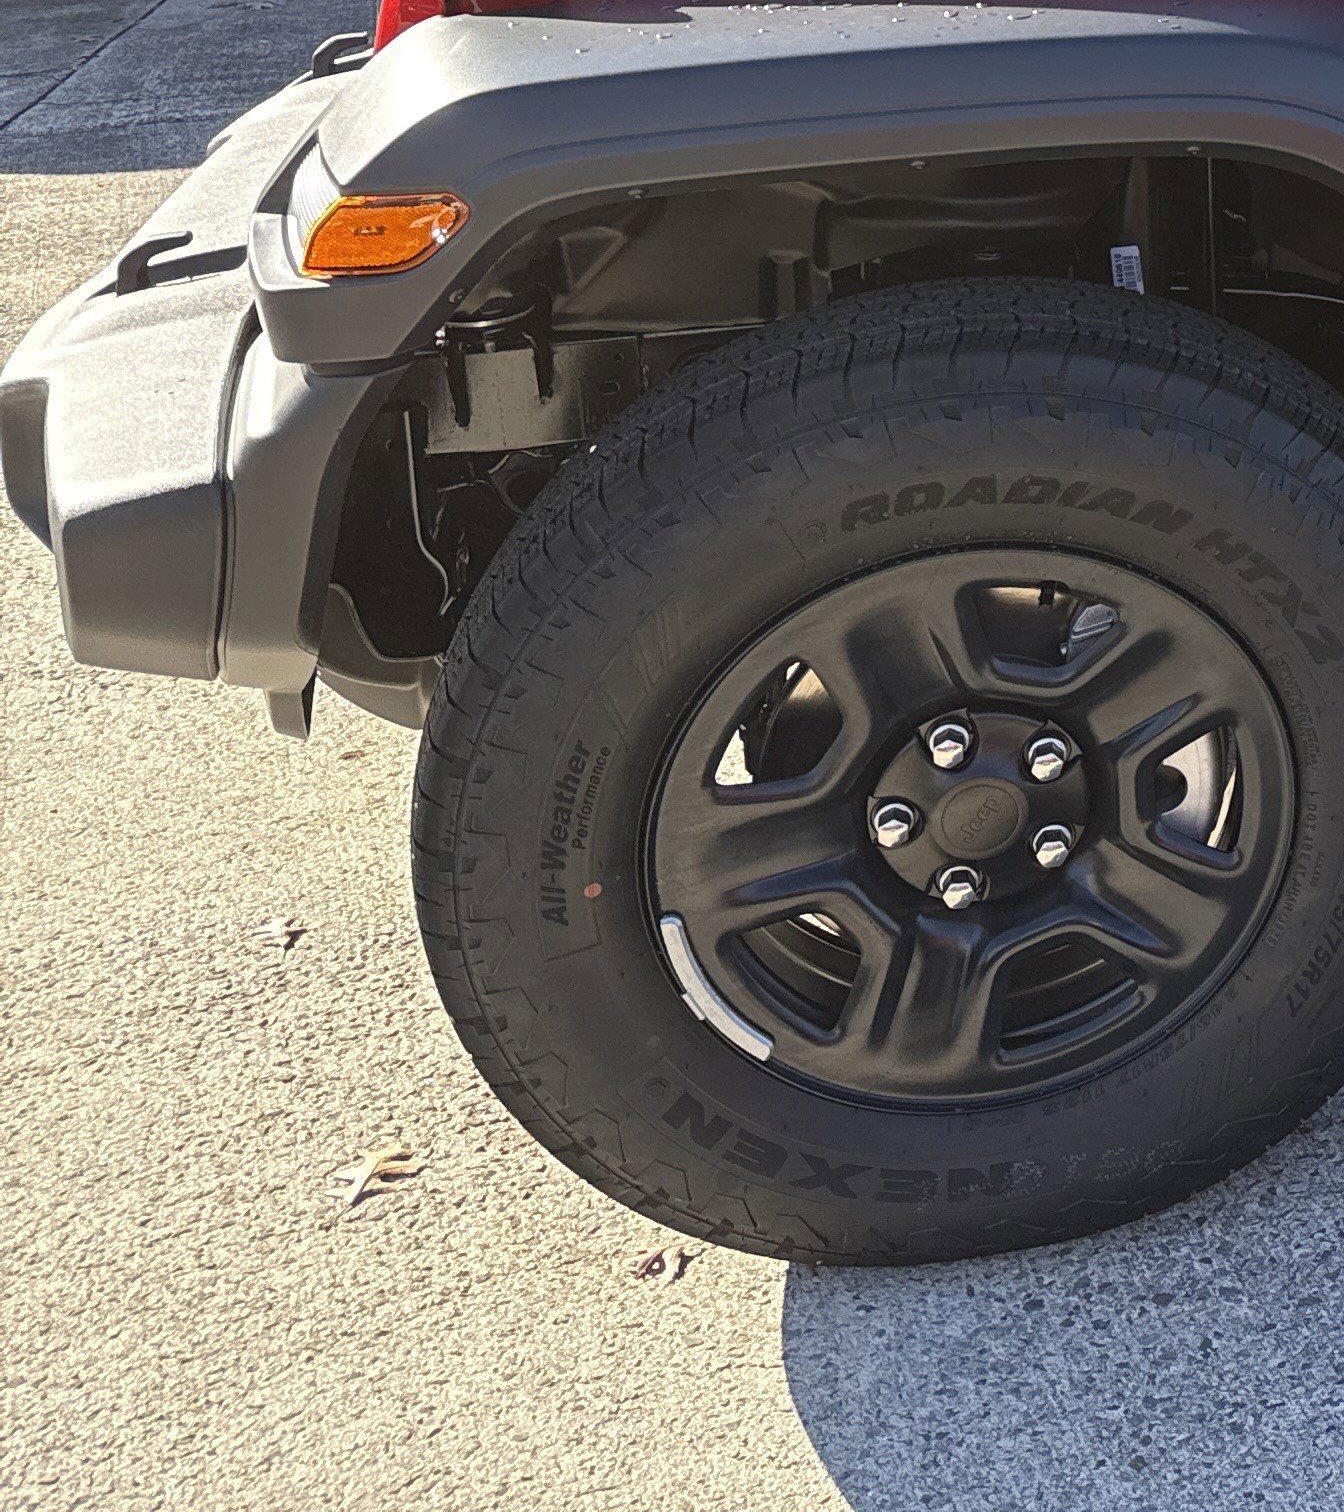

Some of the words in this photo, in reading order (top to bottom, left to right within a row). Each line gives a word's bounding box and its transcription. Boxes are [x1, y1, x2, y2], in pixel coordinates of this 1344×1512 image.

[840, 474, 1194, 536] ROADIAN
[540, 738, 591, 927] All-Weather
[571, 746, 611, 851] Performance
[960, 796, 1000, 844] Jeep
[660, 1093, 1014, 1204] NEXEN
